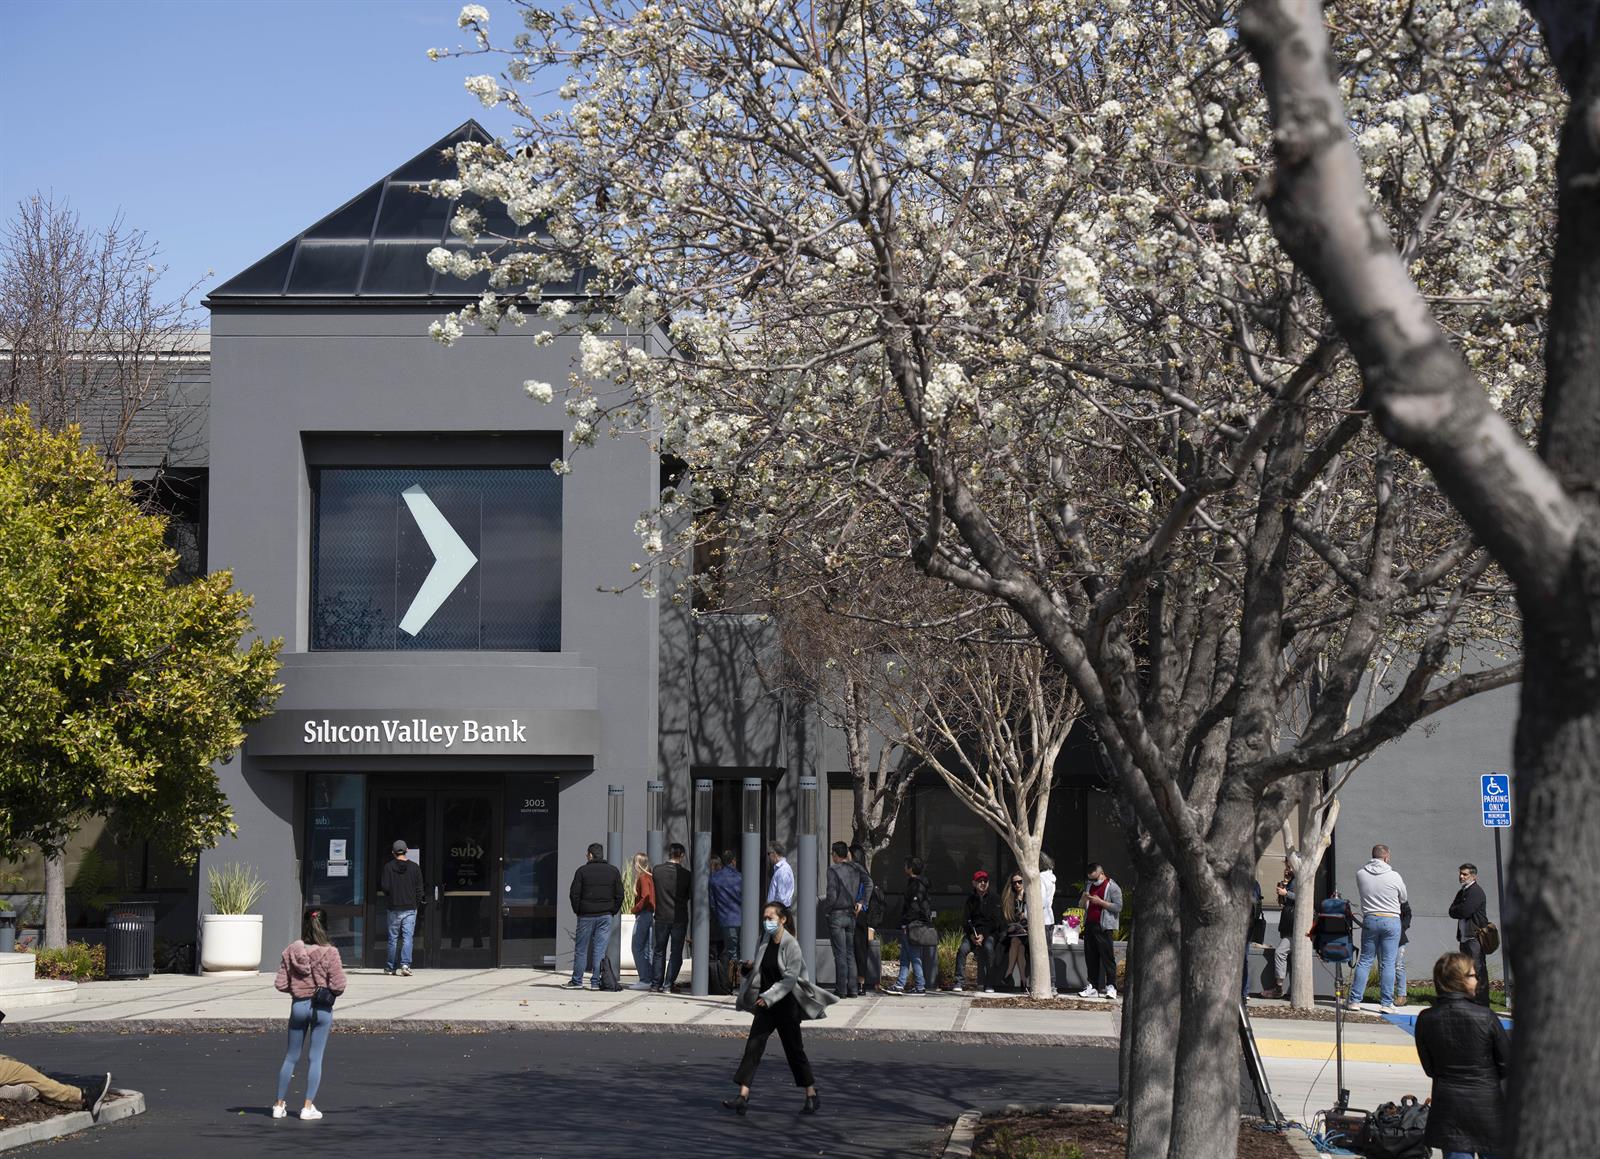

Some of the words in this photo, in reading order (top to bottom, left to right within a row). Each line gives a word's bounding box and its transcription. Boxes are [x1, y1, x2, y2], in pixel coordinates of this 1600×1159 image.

[304, 720, 380, 743] Silicon
[382, 719, 459, 748] Valley
[462, 719, 527, 743] Bank
[1484, 795, 1508, 803] PARKING
[524, 799, 545, 808] 3003
[1489, 803, 1504, 811] ONLY
